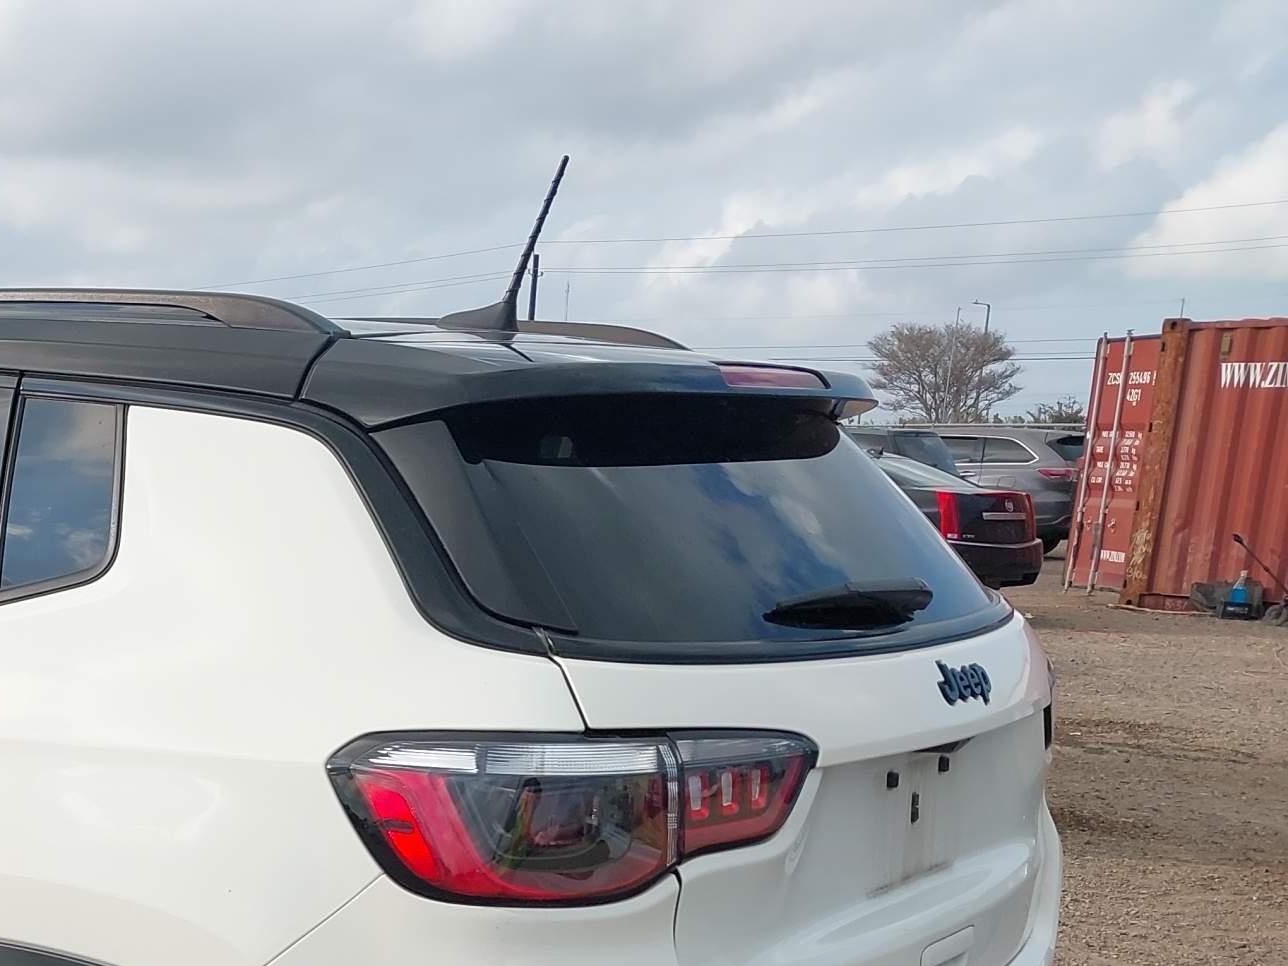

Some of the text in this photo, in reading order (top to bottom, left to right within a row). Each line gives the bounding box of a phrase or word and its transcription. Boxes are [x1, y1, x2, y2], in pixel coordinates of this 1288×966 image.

[1107, 371, 1123, 385] ZCS
[1220, 361, 1288, 389] WWW.ZI
[934, 659, 993, 706] Jeep
